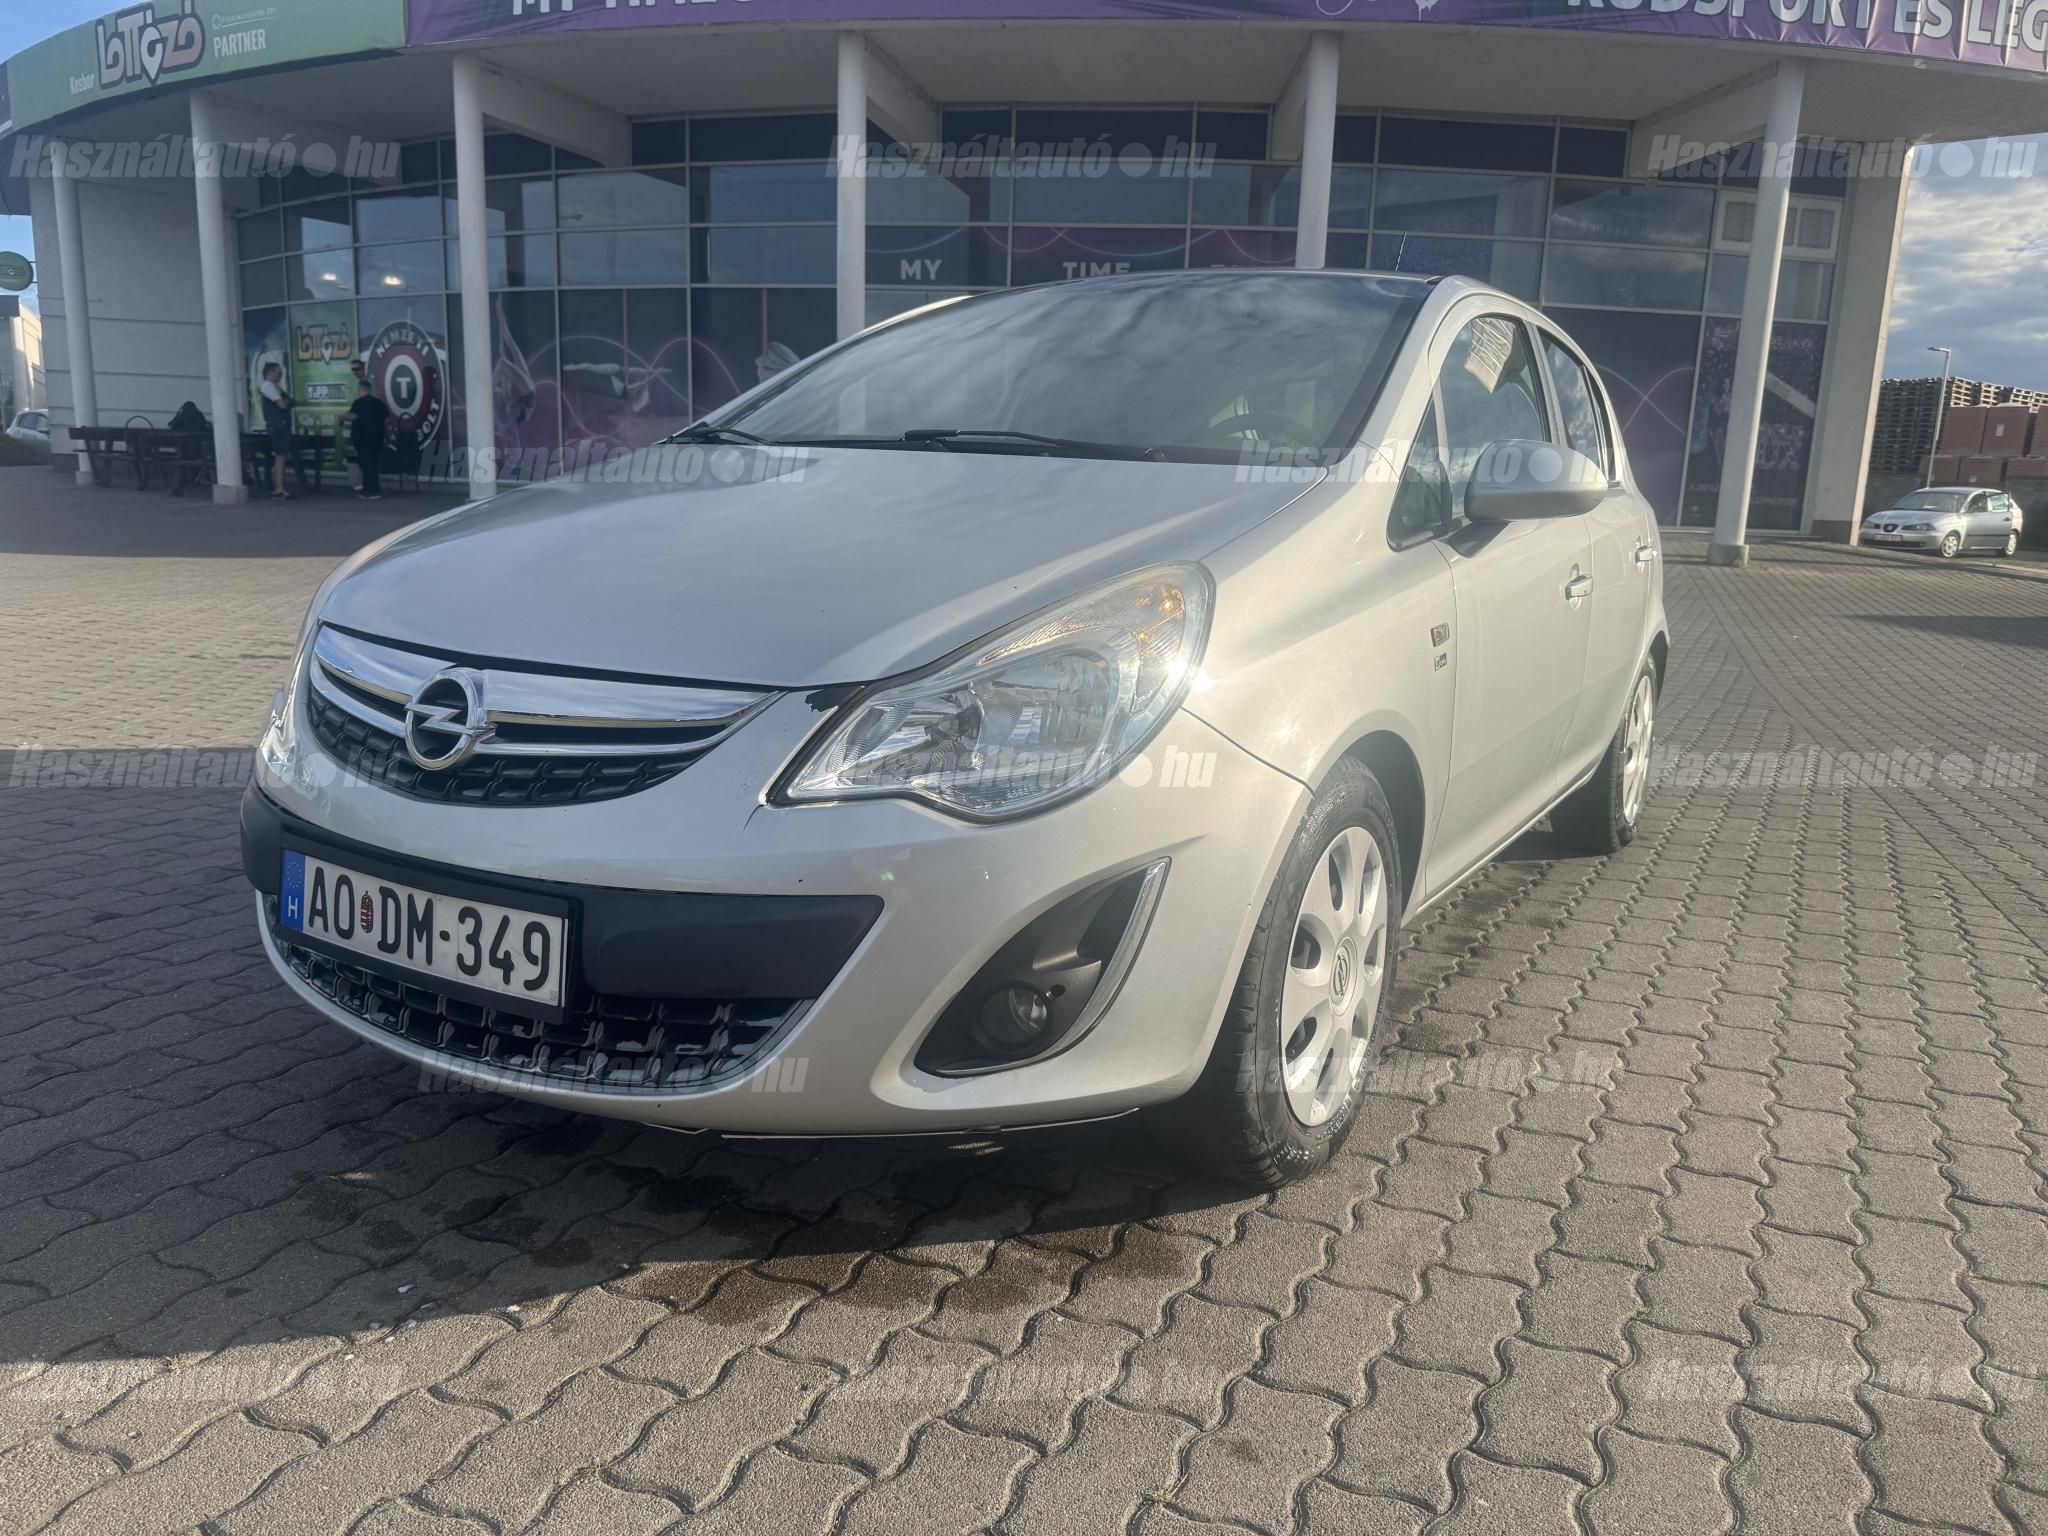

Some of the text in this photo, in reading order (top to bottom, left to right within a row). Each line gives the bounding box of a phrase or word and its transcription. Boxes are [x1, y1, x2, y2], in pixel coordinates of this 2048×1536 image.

[213, 29, 267, 58] PARTNER
[901, 259, 942, 280] MY
[376, 327, 428, 357] NEMZETI
[396, 377, 411, 399] T
[287, 895, 299, 920] H
